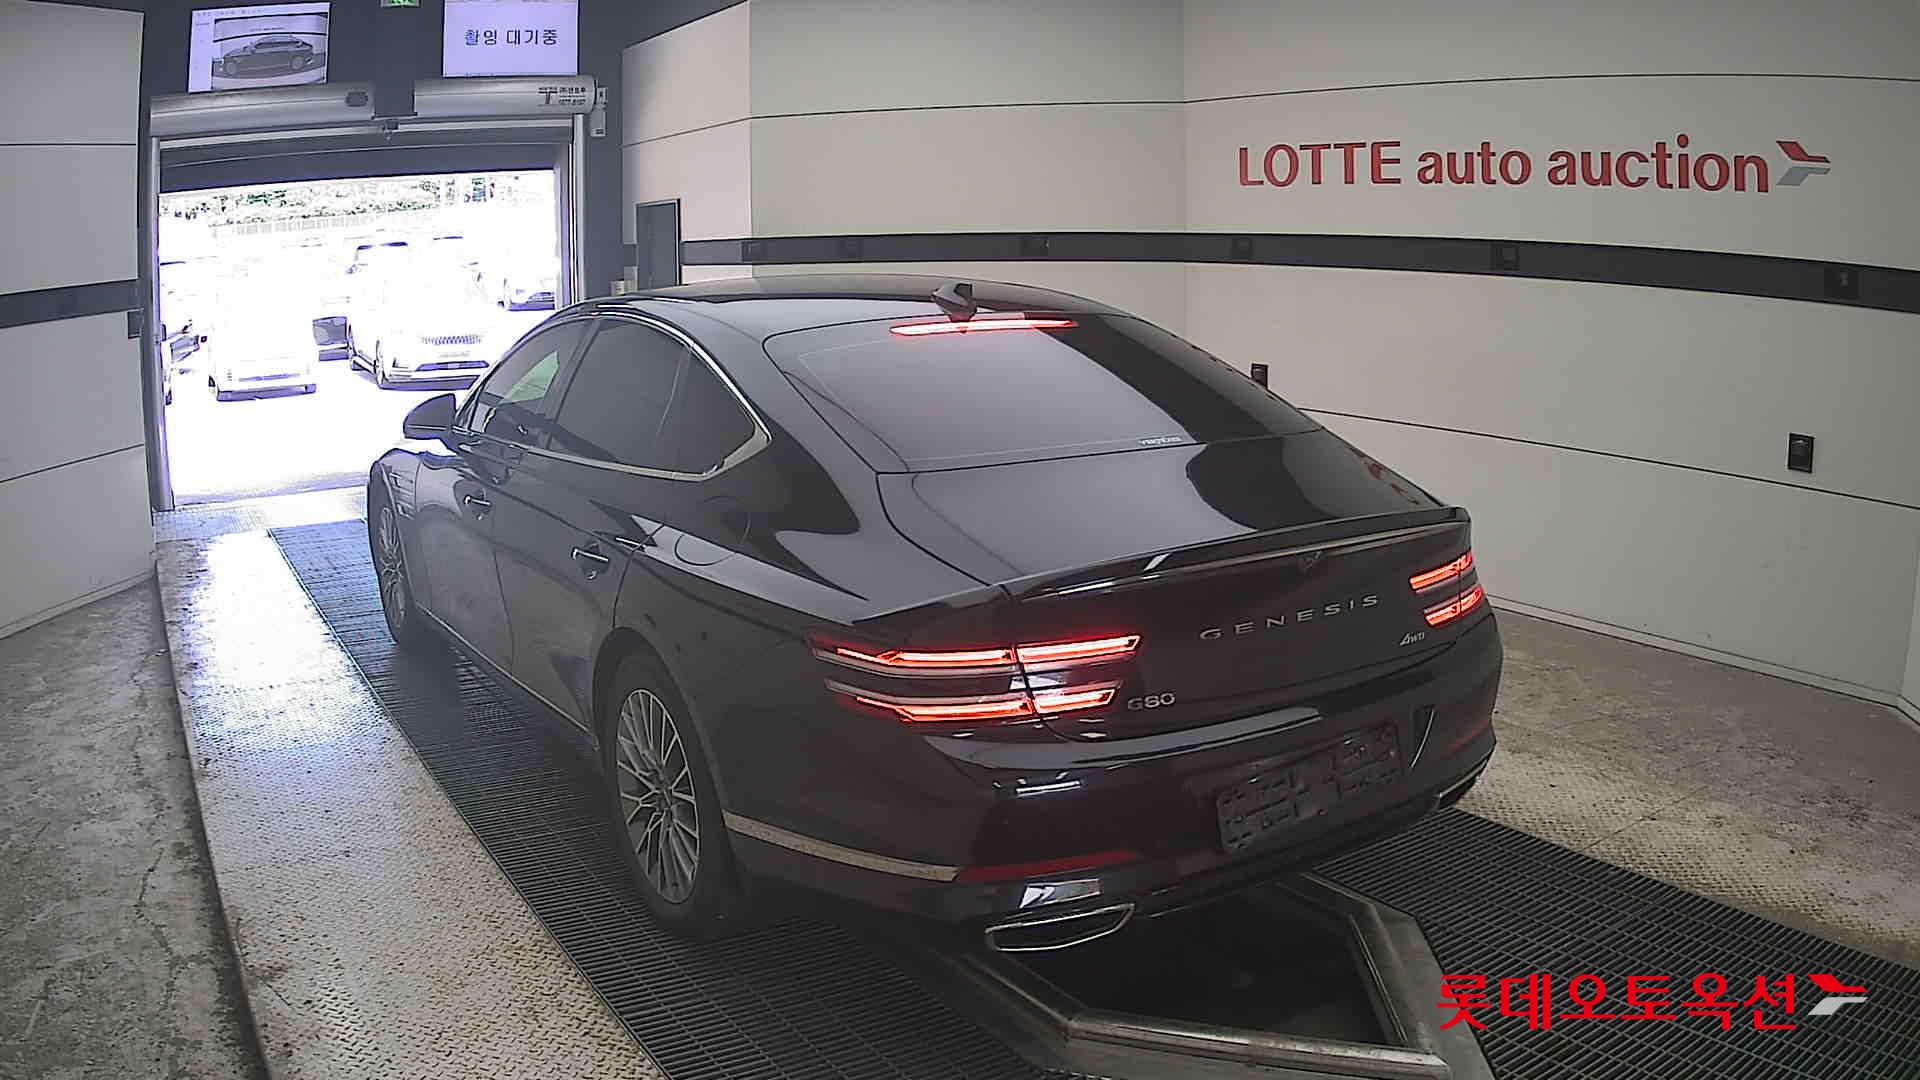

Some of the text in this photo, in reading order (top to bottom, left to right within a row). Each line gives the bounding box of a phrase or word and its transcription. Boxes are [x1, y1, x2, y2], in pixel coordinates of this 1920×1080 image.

[506, 29, 558, 46] 대기중
[1239, 134, 1768, 193] LOTTE auto auction
[1200, 595, 1379, 640] GENESIS
[1400, 631, 1425, 646] AWD
[1127, 692, 1176, 710] G80
